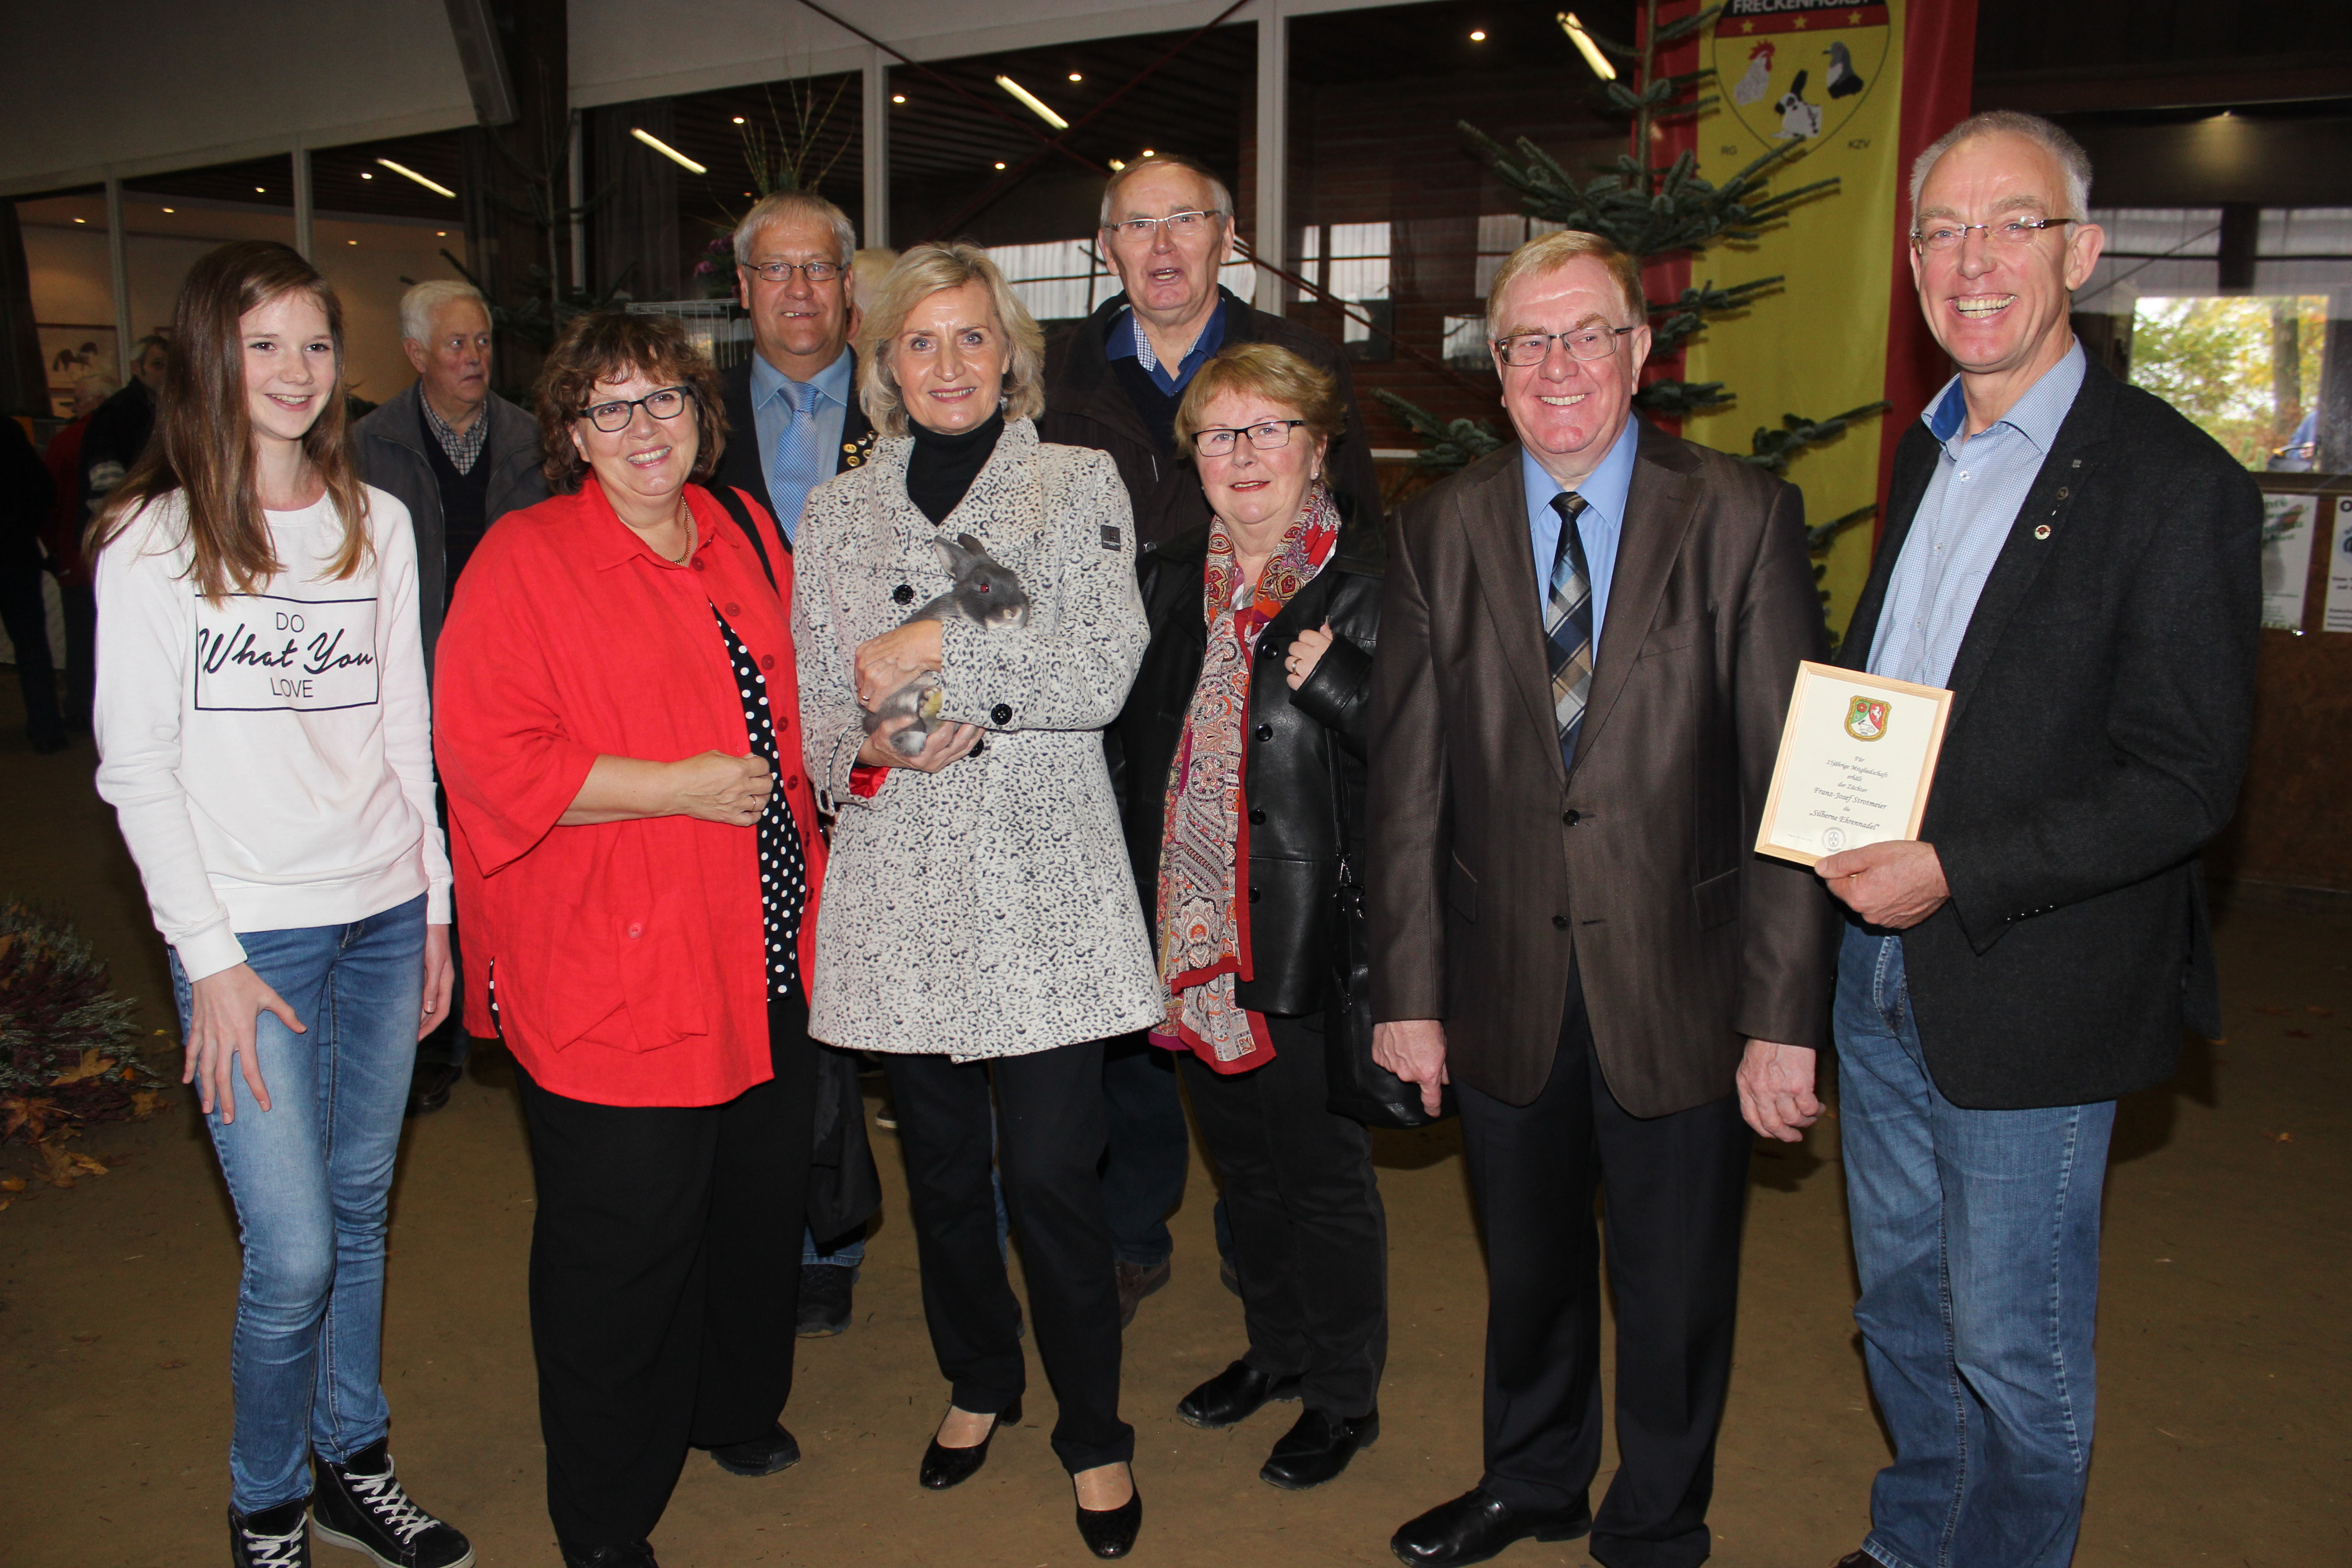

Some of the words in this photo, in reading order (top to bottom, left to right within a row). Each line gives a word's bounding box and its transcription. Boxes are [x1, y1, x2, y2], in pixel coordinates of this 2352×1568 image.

[1733, 0, 1869, 14] FRECKENH
[276, 612, 305, 633] DO
[199, 623, 299, 674] What
[304, 628, 374, 675] You
[270, 677, 314, 699] LOVE
[1826, 760, 1850, 769] 25jährige
[1851, 765, 1888, 779] Mitgliedschaft
[1813, 787, 1853, 803] Franz-Josef
[1852, 797, 1887, 809] Strotmeier
[1847, 784, 1868, 793] Züchter
